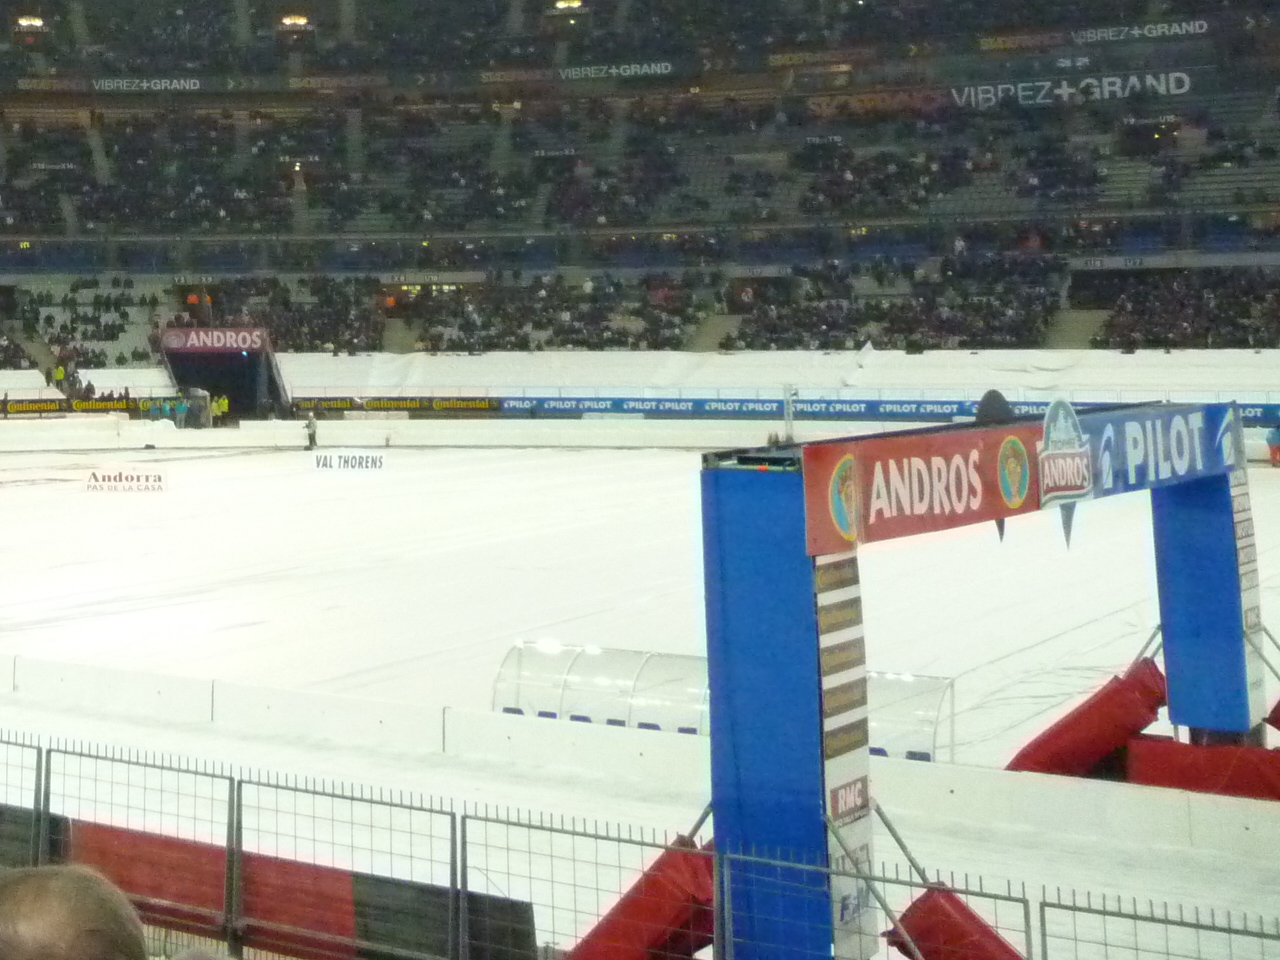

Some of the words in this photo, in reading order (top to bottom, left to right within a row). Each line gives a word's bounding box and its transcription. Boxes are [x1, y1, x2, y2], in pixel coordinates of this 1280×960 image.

[559, 62, 672, 79] VIBREZ+GRAND
[93, 79, 200, 90] VIBREZ+GRAND
[186, 331, 261, 349] ANDROS
[7, 400, 59, 413] Continental
[72, 399, 126, 412] Continental
[364, 399, 421, 410] Continental
[433, 398, 490, 411] Continental
[550, 400, 577, 409] PILOT
[584, 401, 612, 409] PILOT
[629, 401, 658, 410] PILOT
[665, 402, 693, 410] PILOT
[711, 402, 740, 410] PILOT
[749, 402, 778, 411] PILOT
[796, 403, 827, 411] PILOT
[836, 403, 866, 412] PILOT
[886, 404, 917, 412] PILOT
[928, 404, 959, 413] PILOT
[1124, 411, 1205, 485] PILOT
[316, 455, 334, 468] VAL
[338, 455, 383, 469] THORENS
[88, 472, 162, 483] Andorra
[1043, 455, 1089, 489] ANDROS
[869, 448, 982, 524] ANDROS
[839, 782, 863, 814] RMC
